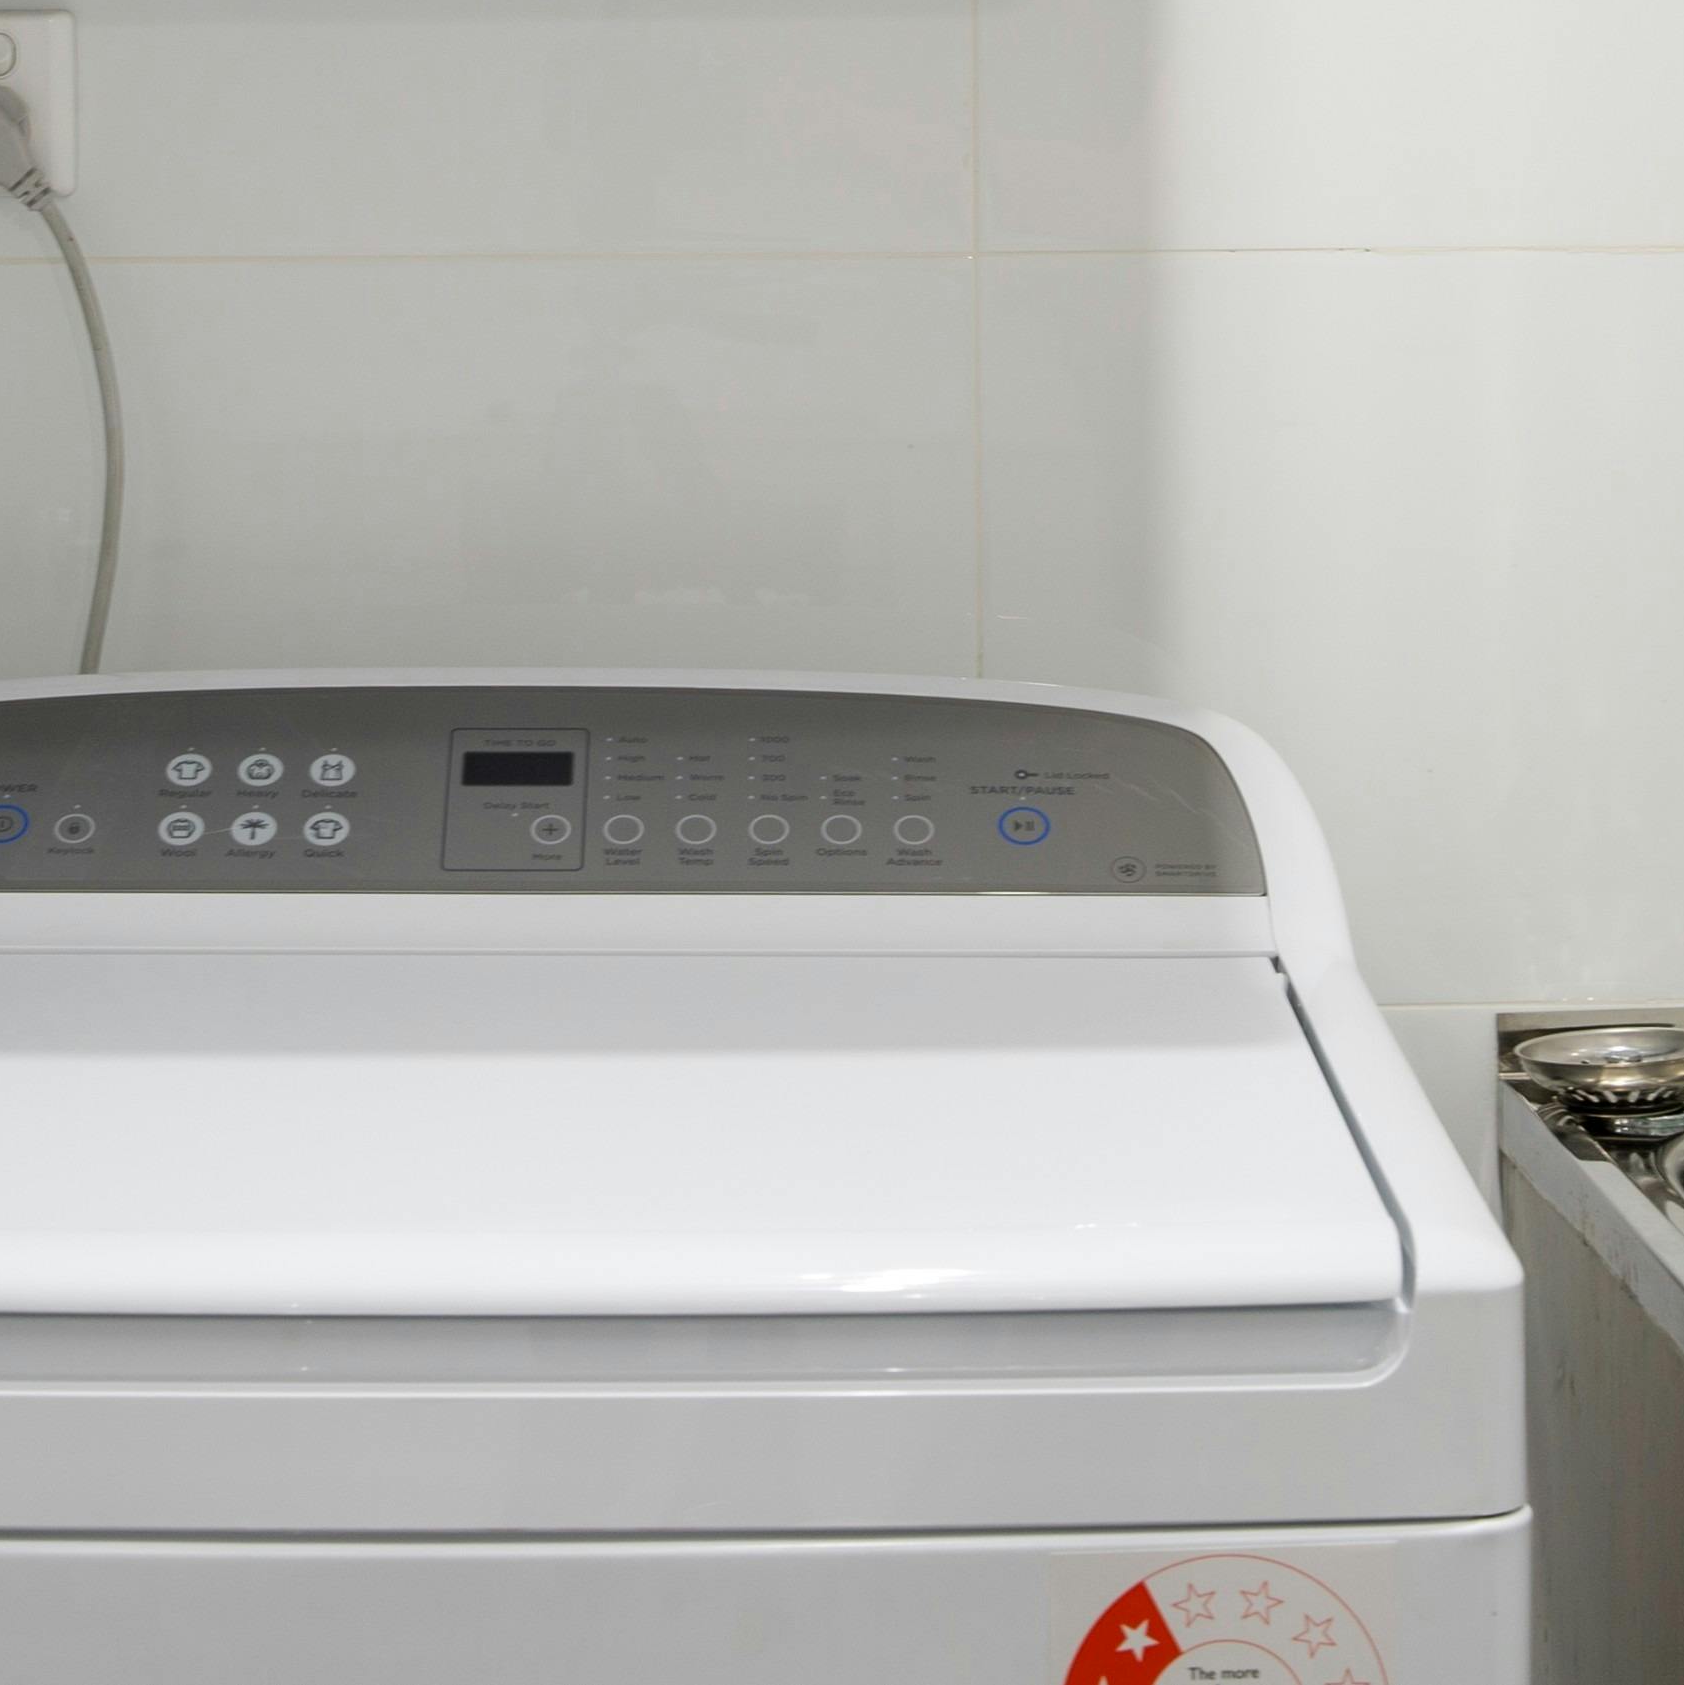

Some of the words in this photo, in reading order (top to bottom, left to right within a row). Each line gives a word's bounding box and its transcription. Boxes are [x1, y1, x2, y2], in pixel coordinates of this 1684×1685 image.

[158, 789, 212, 799] Regular
[236, 789, 280, 799] Heavy
[301, 789, 358, 798] Delicate
[969, 785, 1076, 796] START/PAUSE
[483, 801, 516, 810] Delay
[520, 801, 549, 809] Start
[46, 846, 96, 856] Keylock
[160, 848, 197, 857] Wool
[224, 848, 277, 859] Allergy
[303, 848, 346, 858] Quick
[603, 847, 643, 856] Water
[677, 847, 714, 856] Wash
[754, 847, 783, 857] Spin
[815, 847, 868, 857] Options
[895, 847, 933, 856] Wash
[531, 853, 563, 861] More
[747, 857, 790, 866] Speed
[886, 857, 943, 866] Advance
[678, 858, 714, 866] Temp
[1187, 1667, 1217, 1681] The
[1220, 1667, 1260, 1679] more
